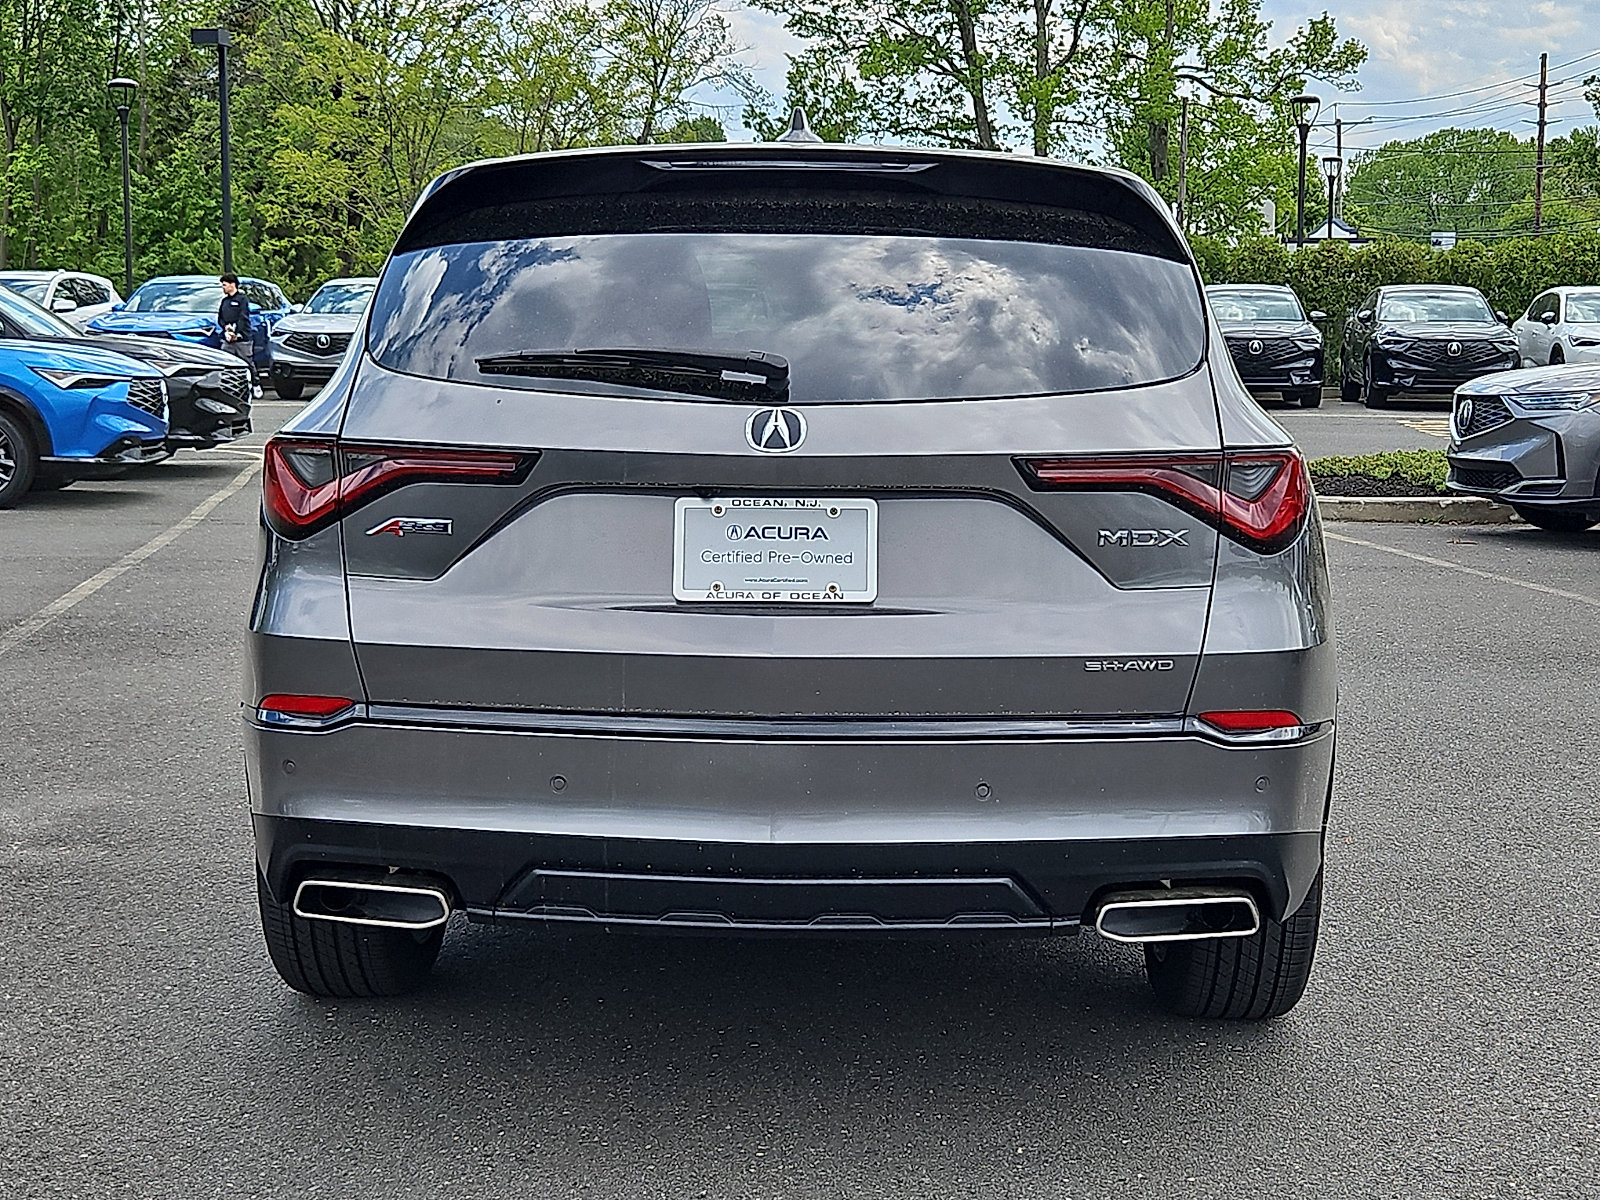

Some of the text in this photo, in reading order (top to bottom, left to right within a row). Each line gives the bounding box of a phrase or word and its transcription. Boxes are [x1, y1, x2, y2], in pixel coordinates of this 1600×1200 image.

[795, 499, 821, 507] N.J.
[744, 526, 829, 540] ACURA
[1098, 529, 1190, 547] MDX
[701, 550, 853, 564] Certified Pre-Owned
[706, 591, 755, 599] ACURA
[790, 592, 844, 600] OCEAN
[1084, 660, 1174, 671] SH-AWD
